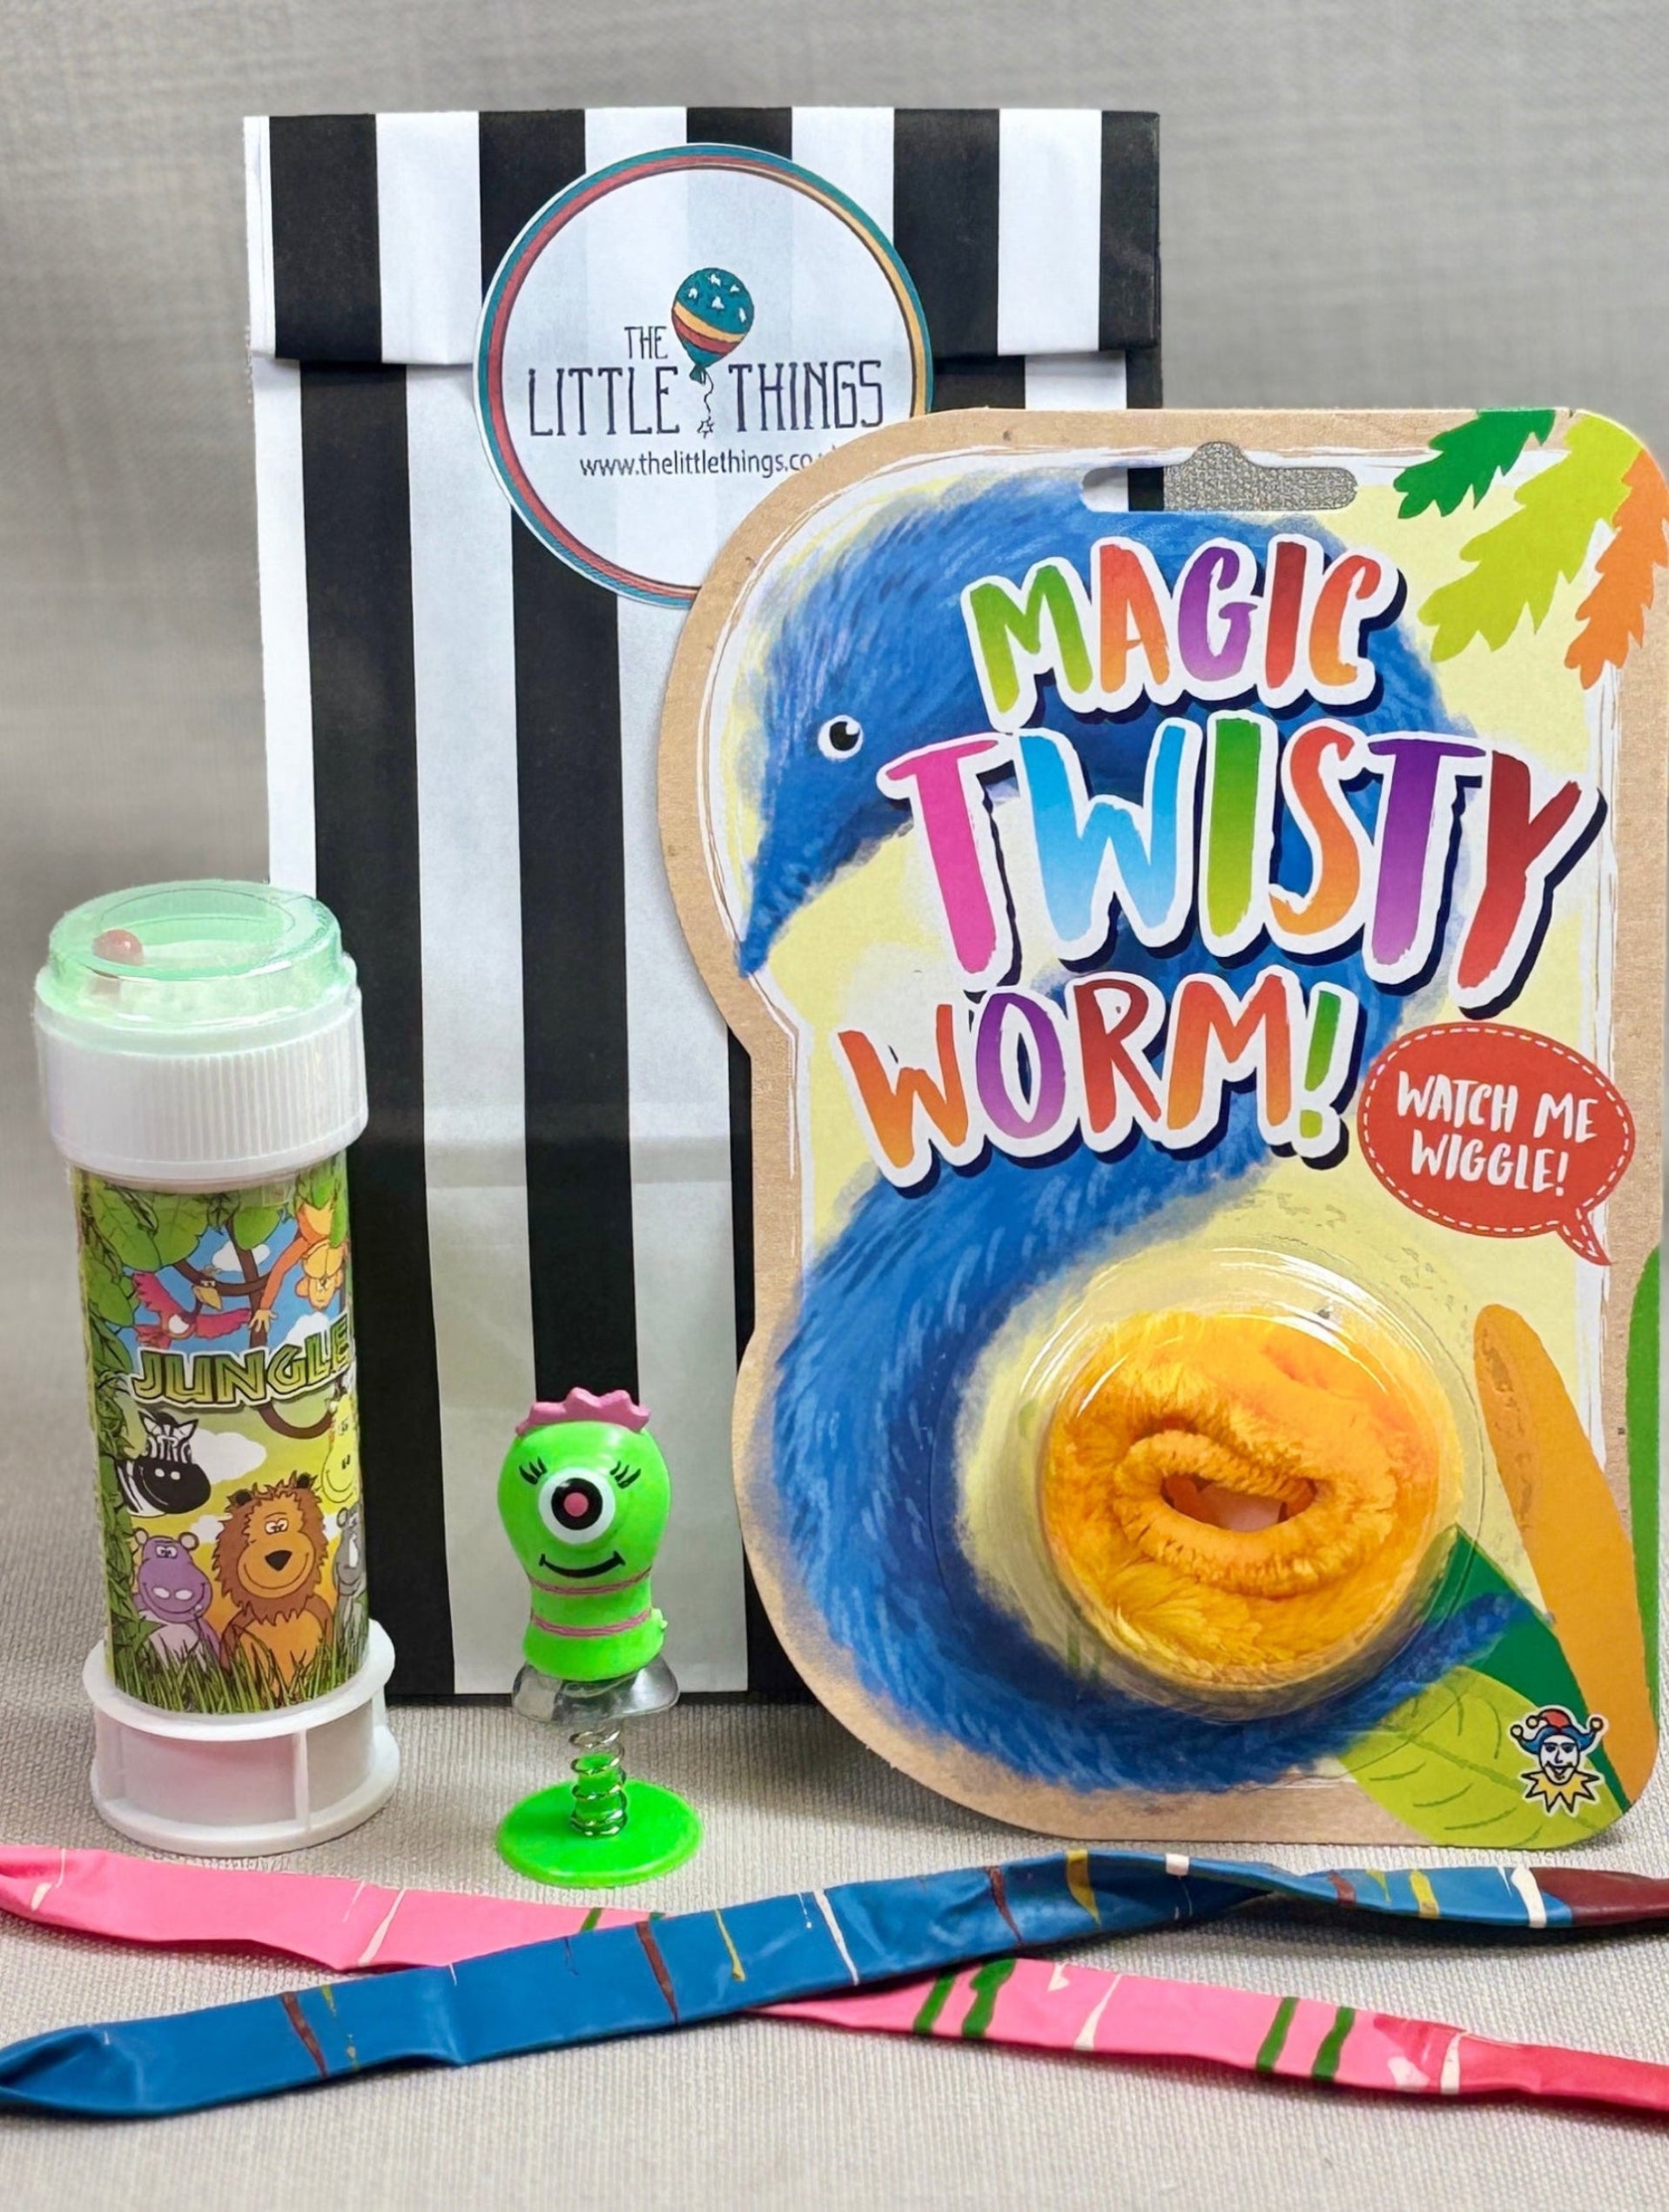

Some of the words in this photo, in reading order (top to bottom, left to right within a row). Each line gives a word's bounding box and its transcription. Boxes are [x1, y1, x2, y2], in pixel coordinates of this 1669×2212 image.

[623, 325, 669, 361] THE
[528, 366, 682, 437] LITTLE
[727, 360, 885, 433] THINGS
[966, 538, 1393, 721] MAGIC
[881, 714, 1592, 997] TWISTY
[838, 971, 1349, 1180] WORM!
[1396, 1069, 1519, 1133] WATCH
[1533, 1092, 1599, 1143] ME
[1410, 1128, 1570, 1197] WIGGLE!
[132, 1312, 350, 1406] JUNGLE
